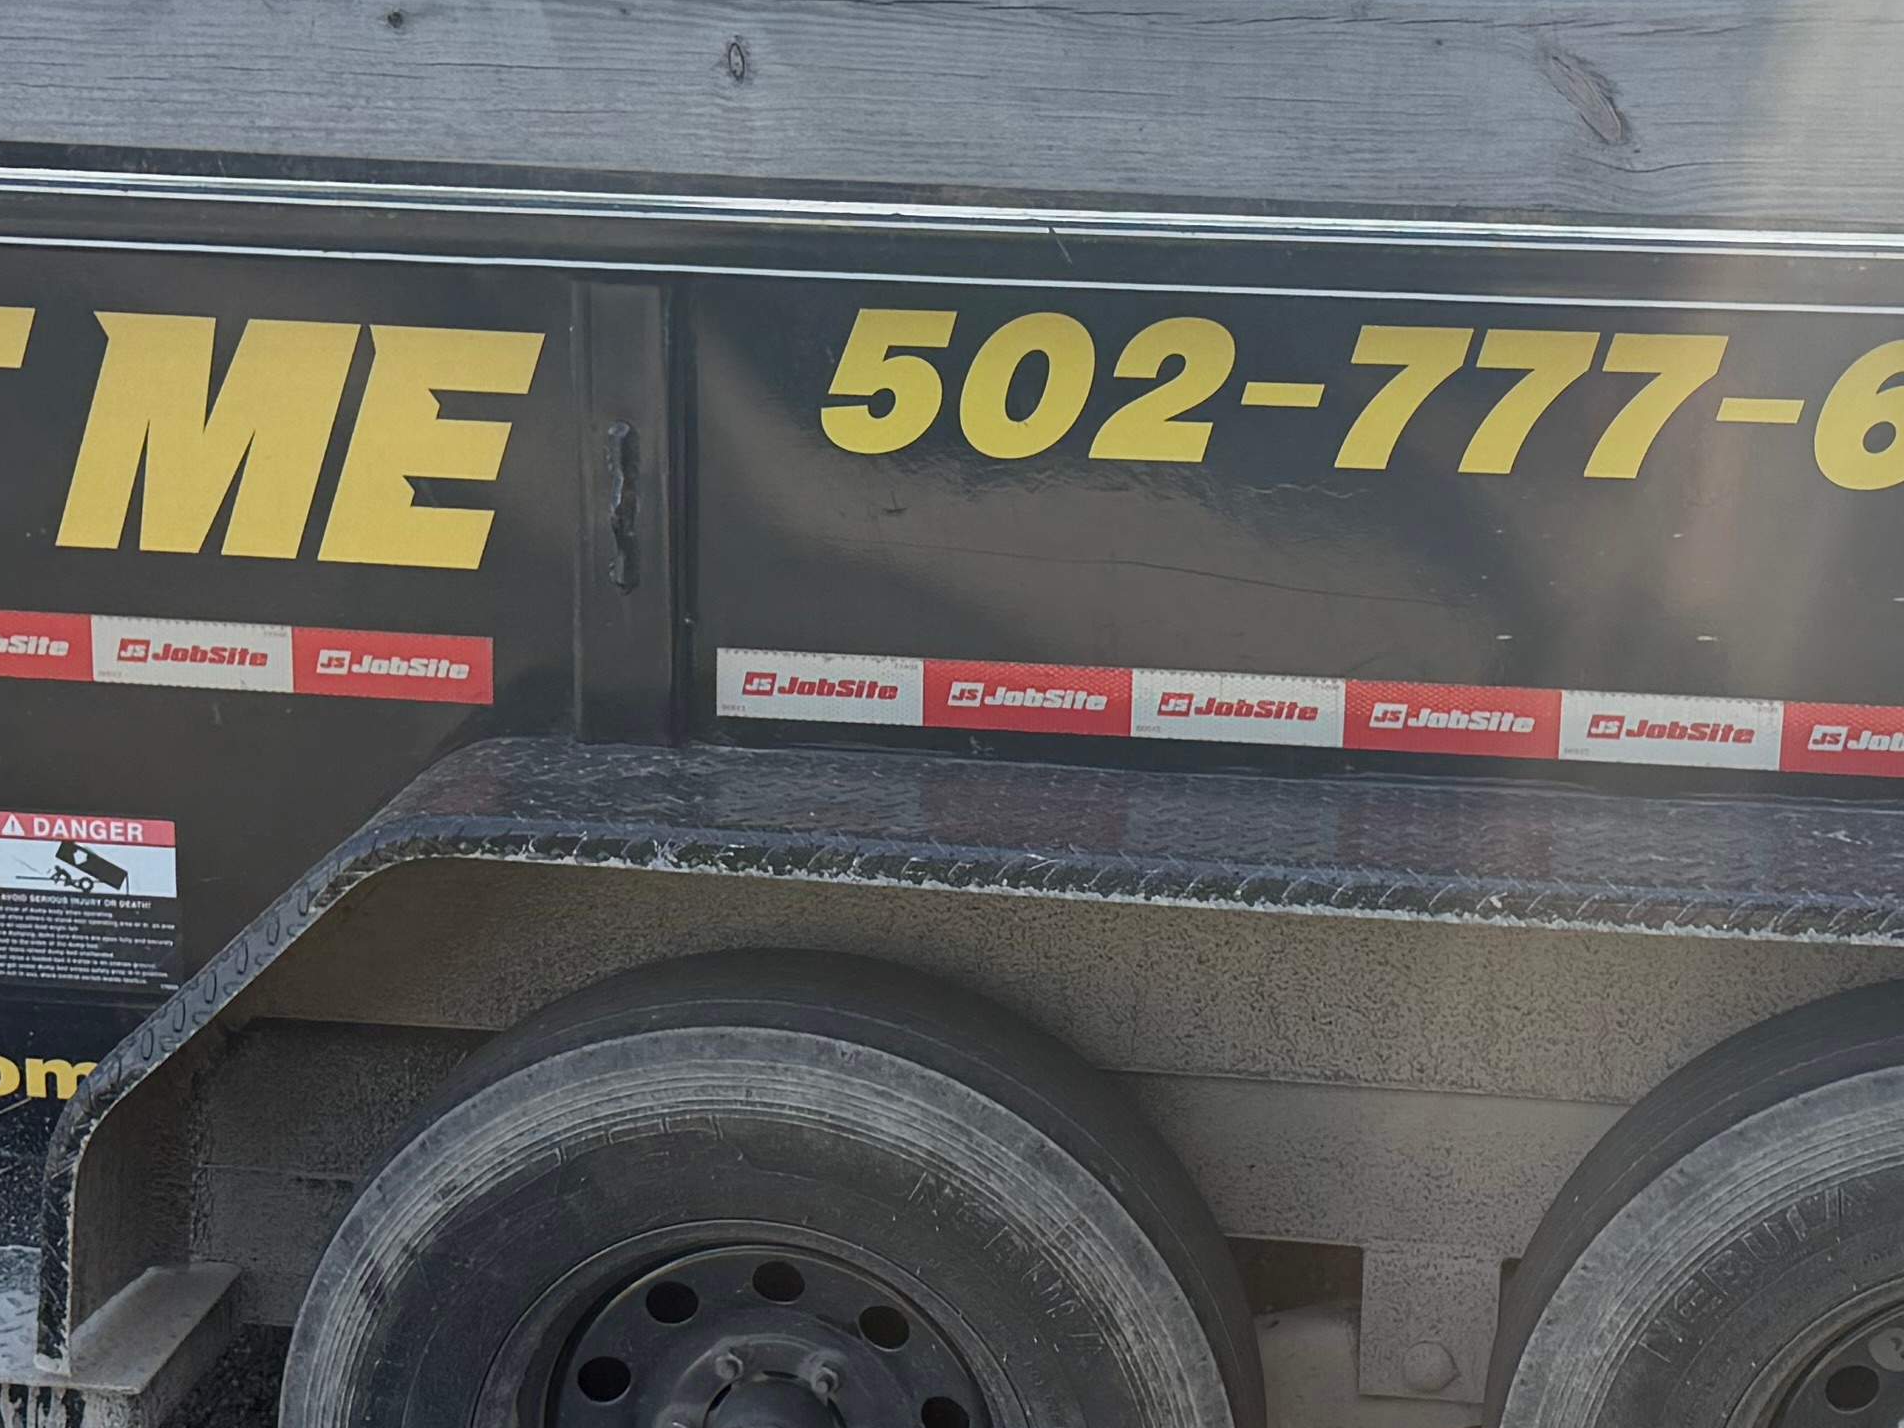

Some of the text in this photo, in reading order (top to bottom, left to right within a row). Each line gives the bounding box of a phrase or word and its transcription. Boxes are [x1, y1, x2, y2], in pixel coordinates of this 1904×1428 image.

[55, 310, 546, 570] ME
[153, 643, 268, 666] JobSite
[353, 655, 469, 679] JobSite
[777, 677, 899, 701] JobSite
[985, 687, 1107, 711] JobSite
[1195, 697, 1319, 720] JobSite
[1407, 708, 1534, 732] JobSite
[1627, 719, 1754, 744] JobSite
[33, 817, 144, 842] DANGER
[104, 899, 116, 907] OR
